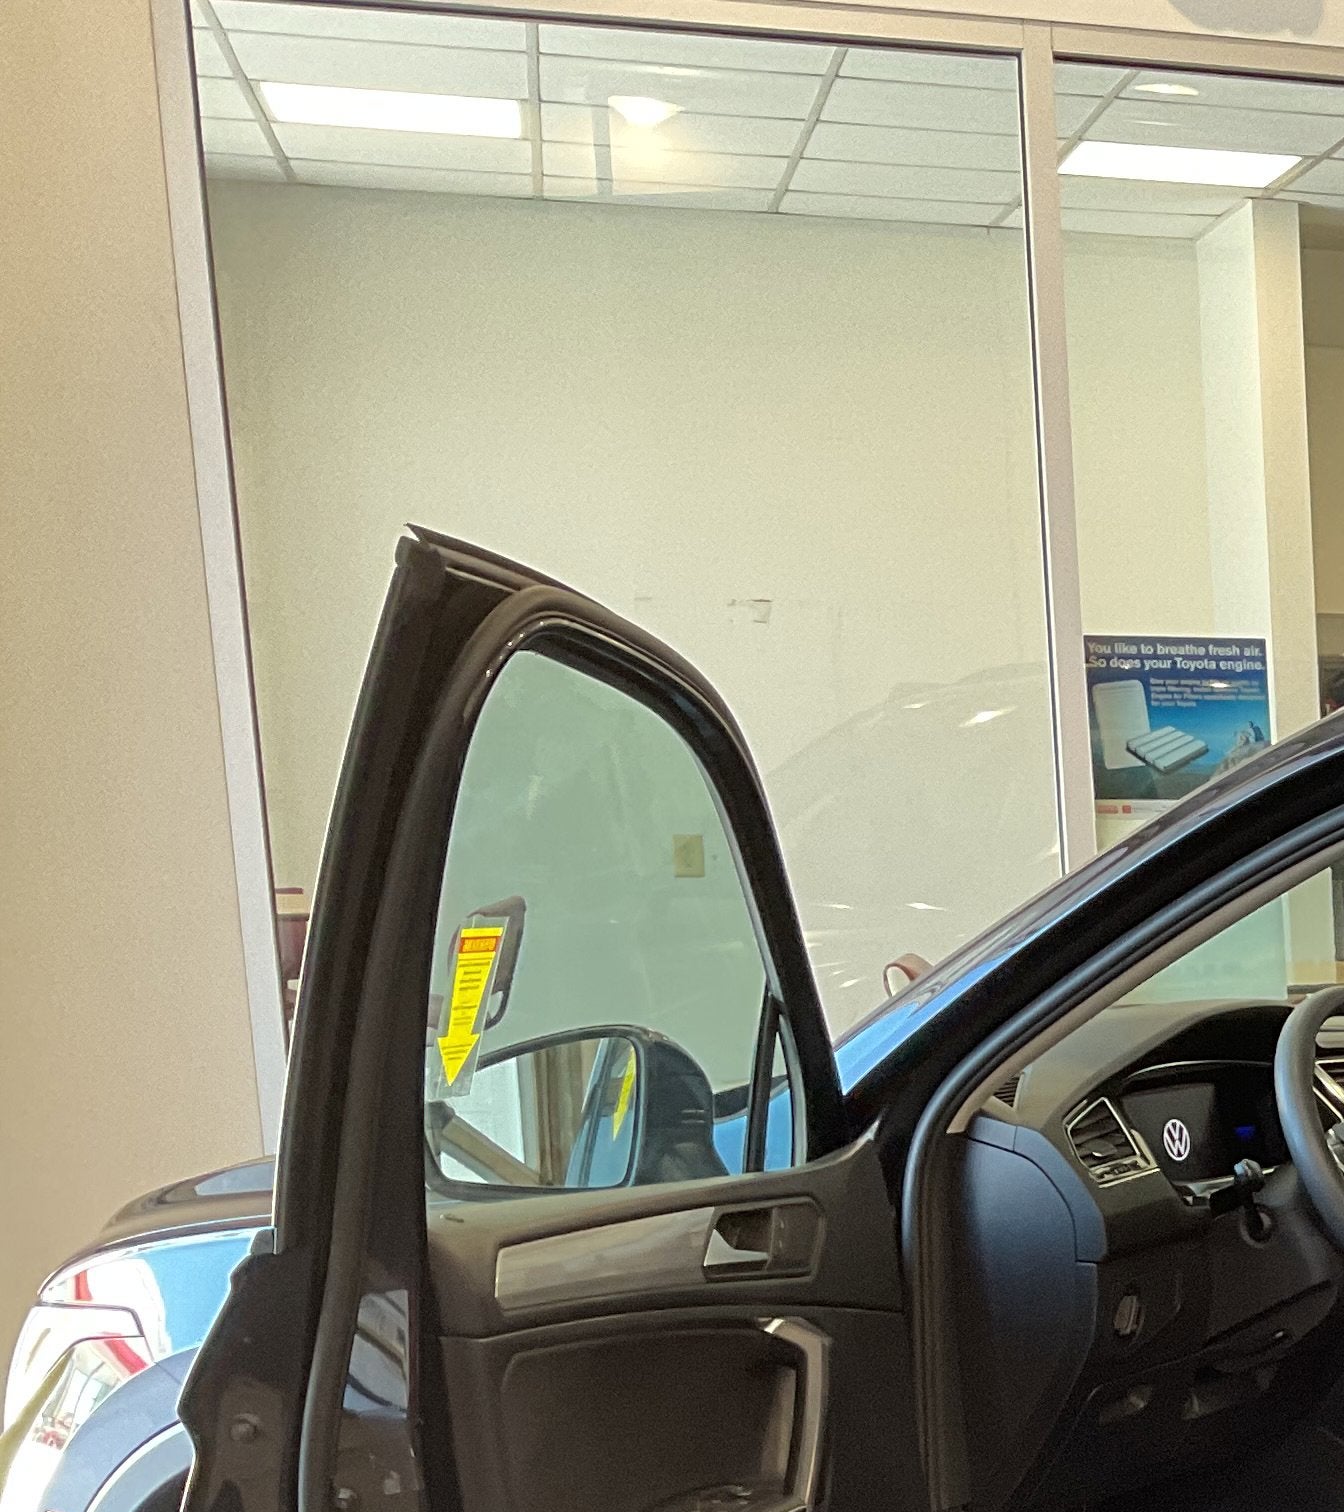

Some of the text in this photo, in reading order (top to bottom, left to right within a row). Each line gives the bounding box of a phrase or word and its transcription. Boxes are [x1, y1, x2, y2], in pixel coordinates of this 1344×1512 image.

[1087, 642, 1263, 657] You like to breathe fresh air.
[1089, 656, 1265, 673] So does your Toyota engine.
